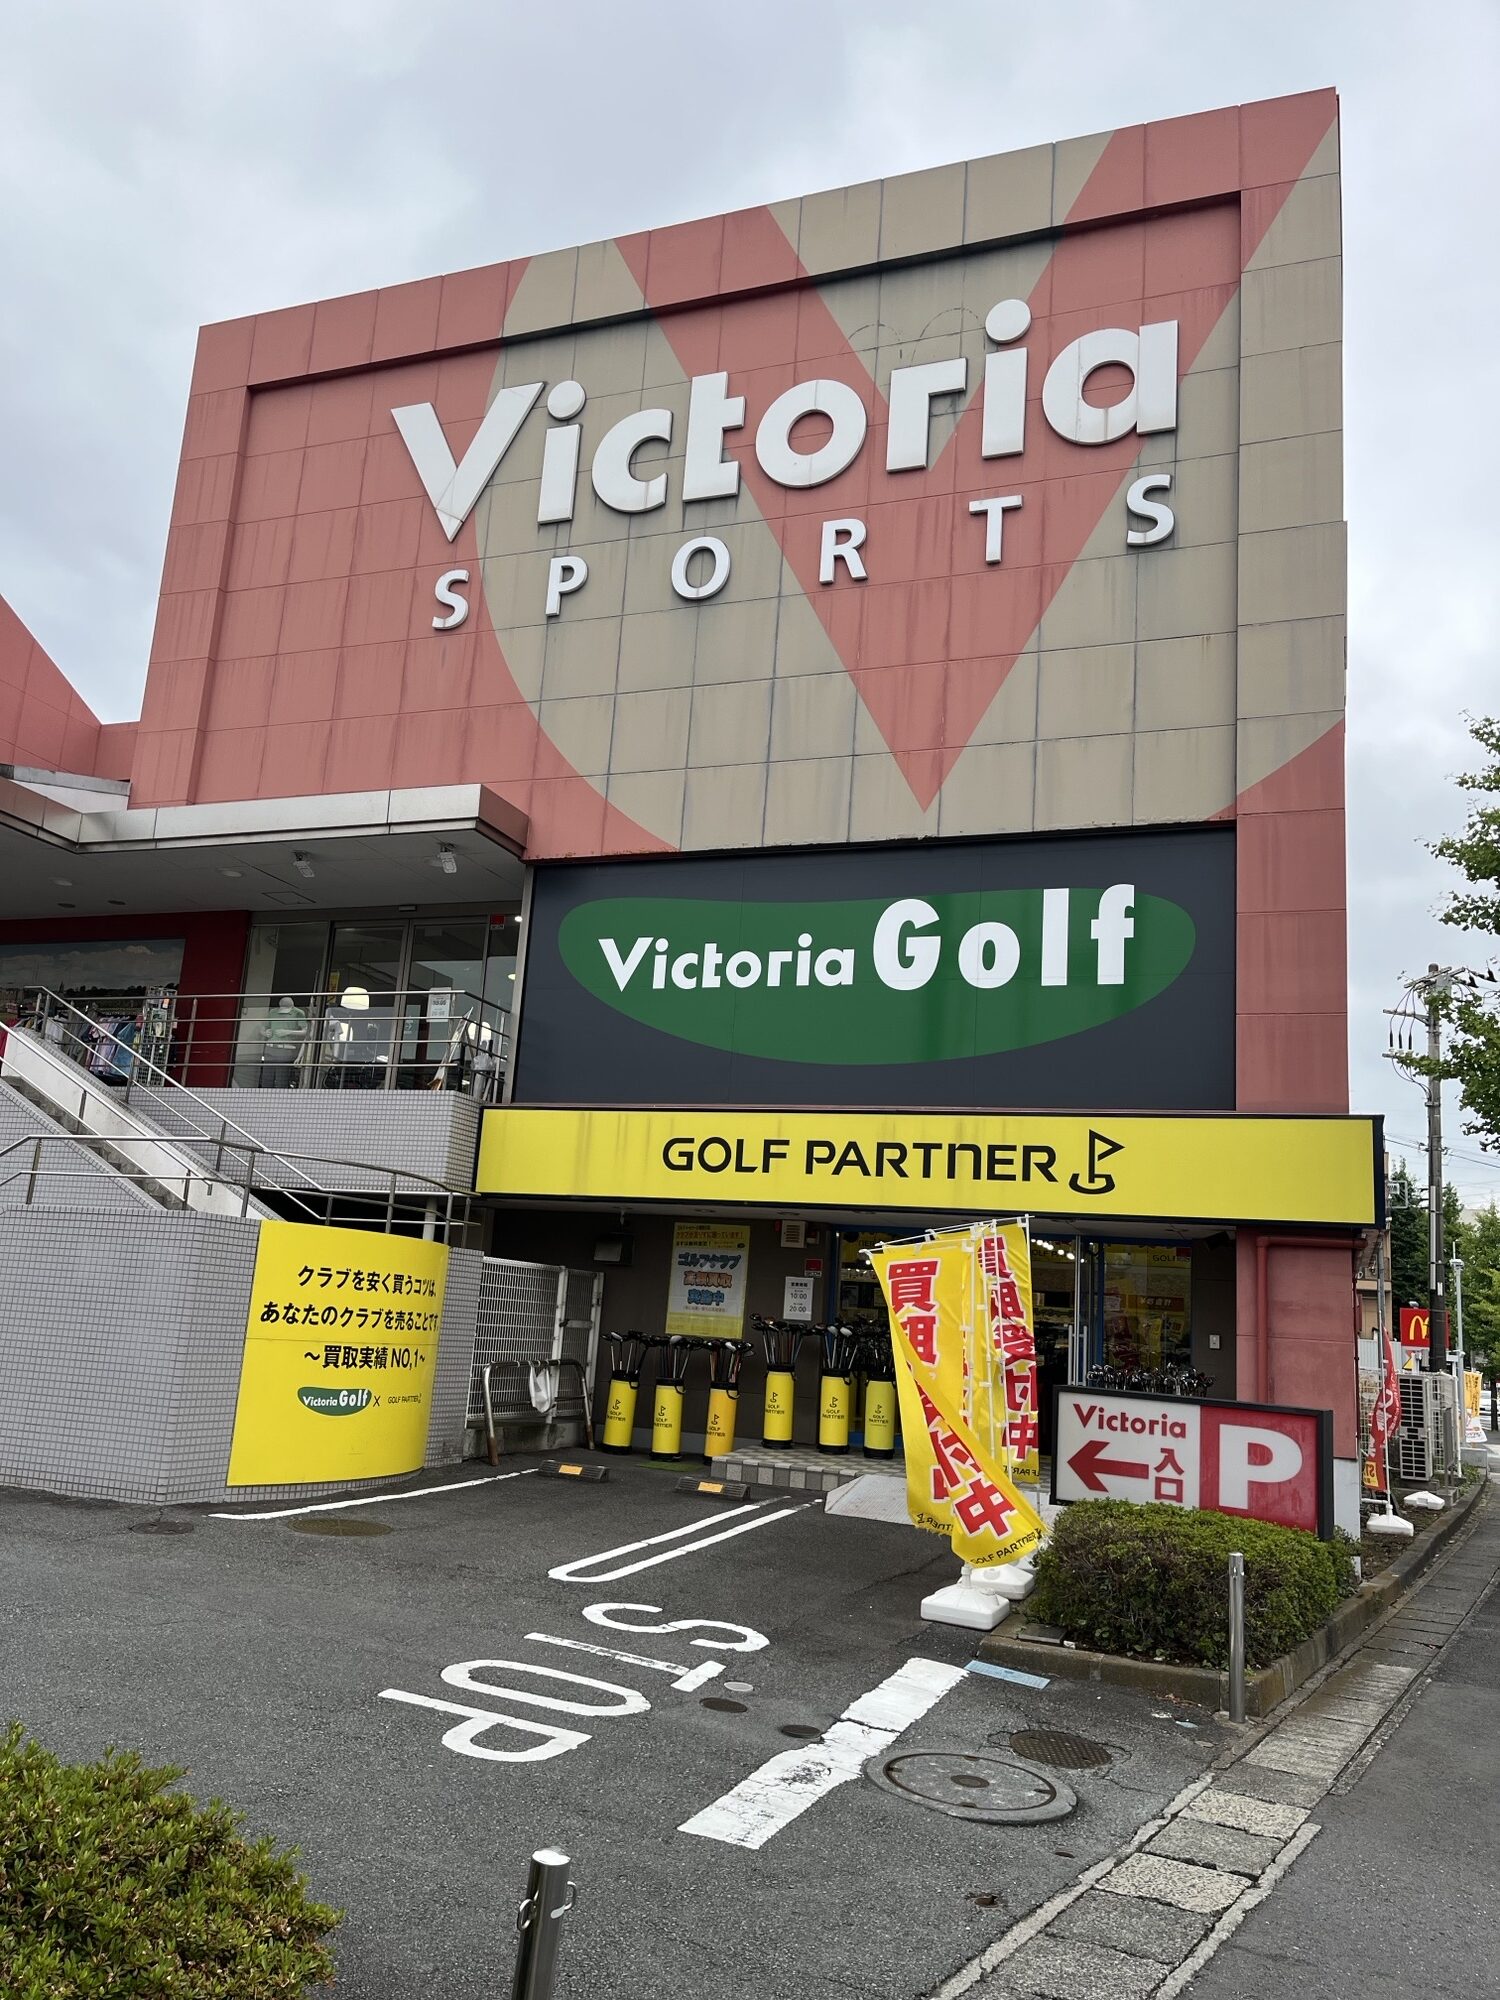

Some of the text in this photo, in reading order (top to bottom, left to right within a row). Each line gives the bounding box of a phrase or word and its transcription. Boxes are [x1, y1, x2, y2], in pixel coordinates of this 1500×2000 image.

[390, 298, 1179, 544] Victoria
[432, 473, 1175, 631] SPORTS
[598, 884, 1136, 992] Victoria Golf
[662, 1136, 1058, 1183] GOLF PARTNER
[302, 1395, 337, 1407] Victoria
[339, 1388, 368, 1407] Golf
[1072, 1403, 1187, 1439] Victoria
[1154, 1447, 1185, 1504] 入口
[1218, 1423, 1303, 1510] P
[378, 1602, 770, 1762] STOP
